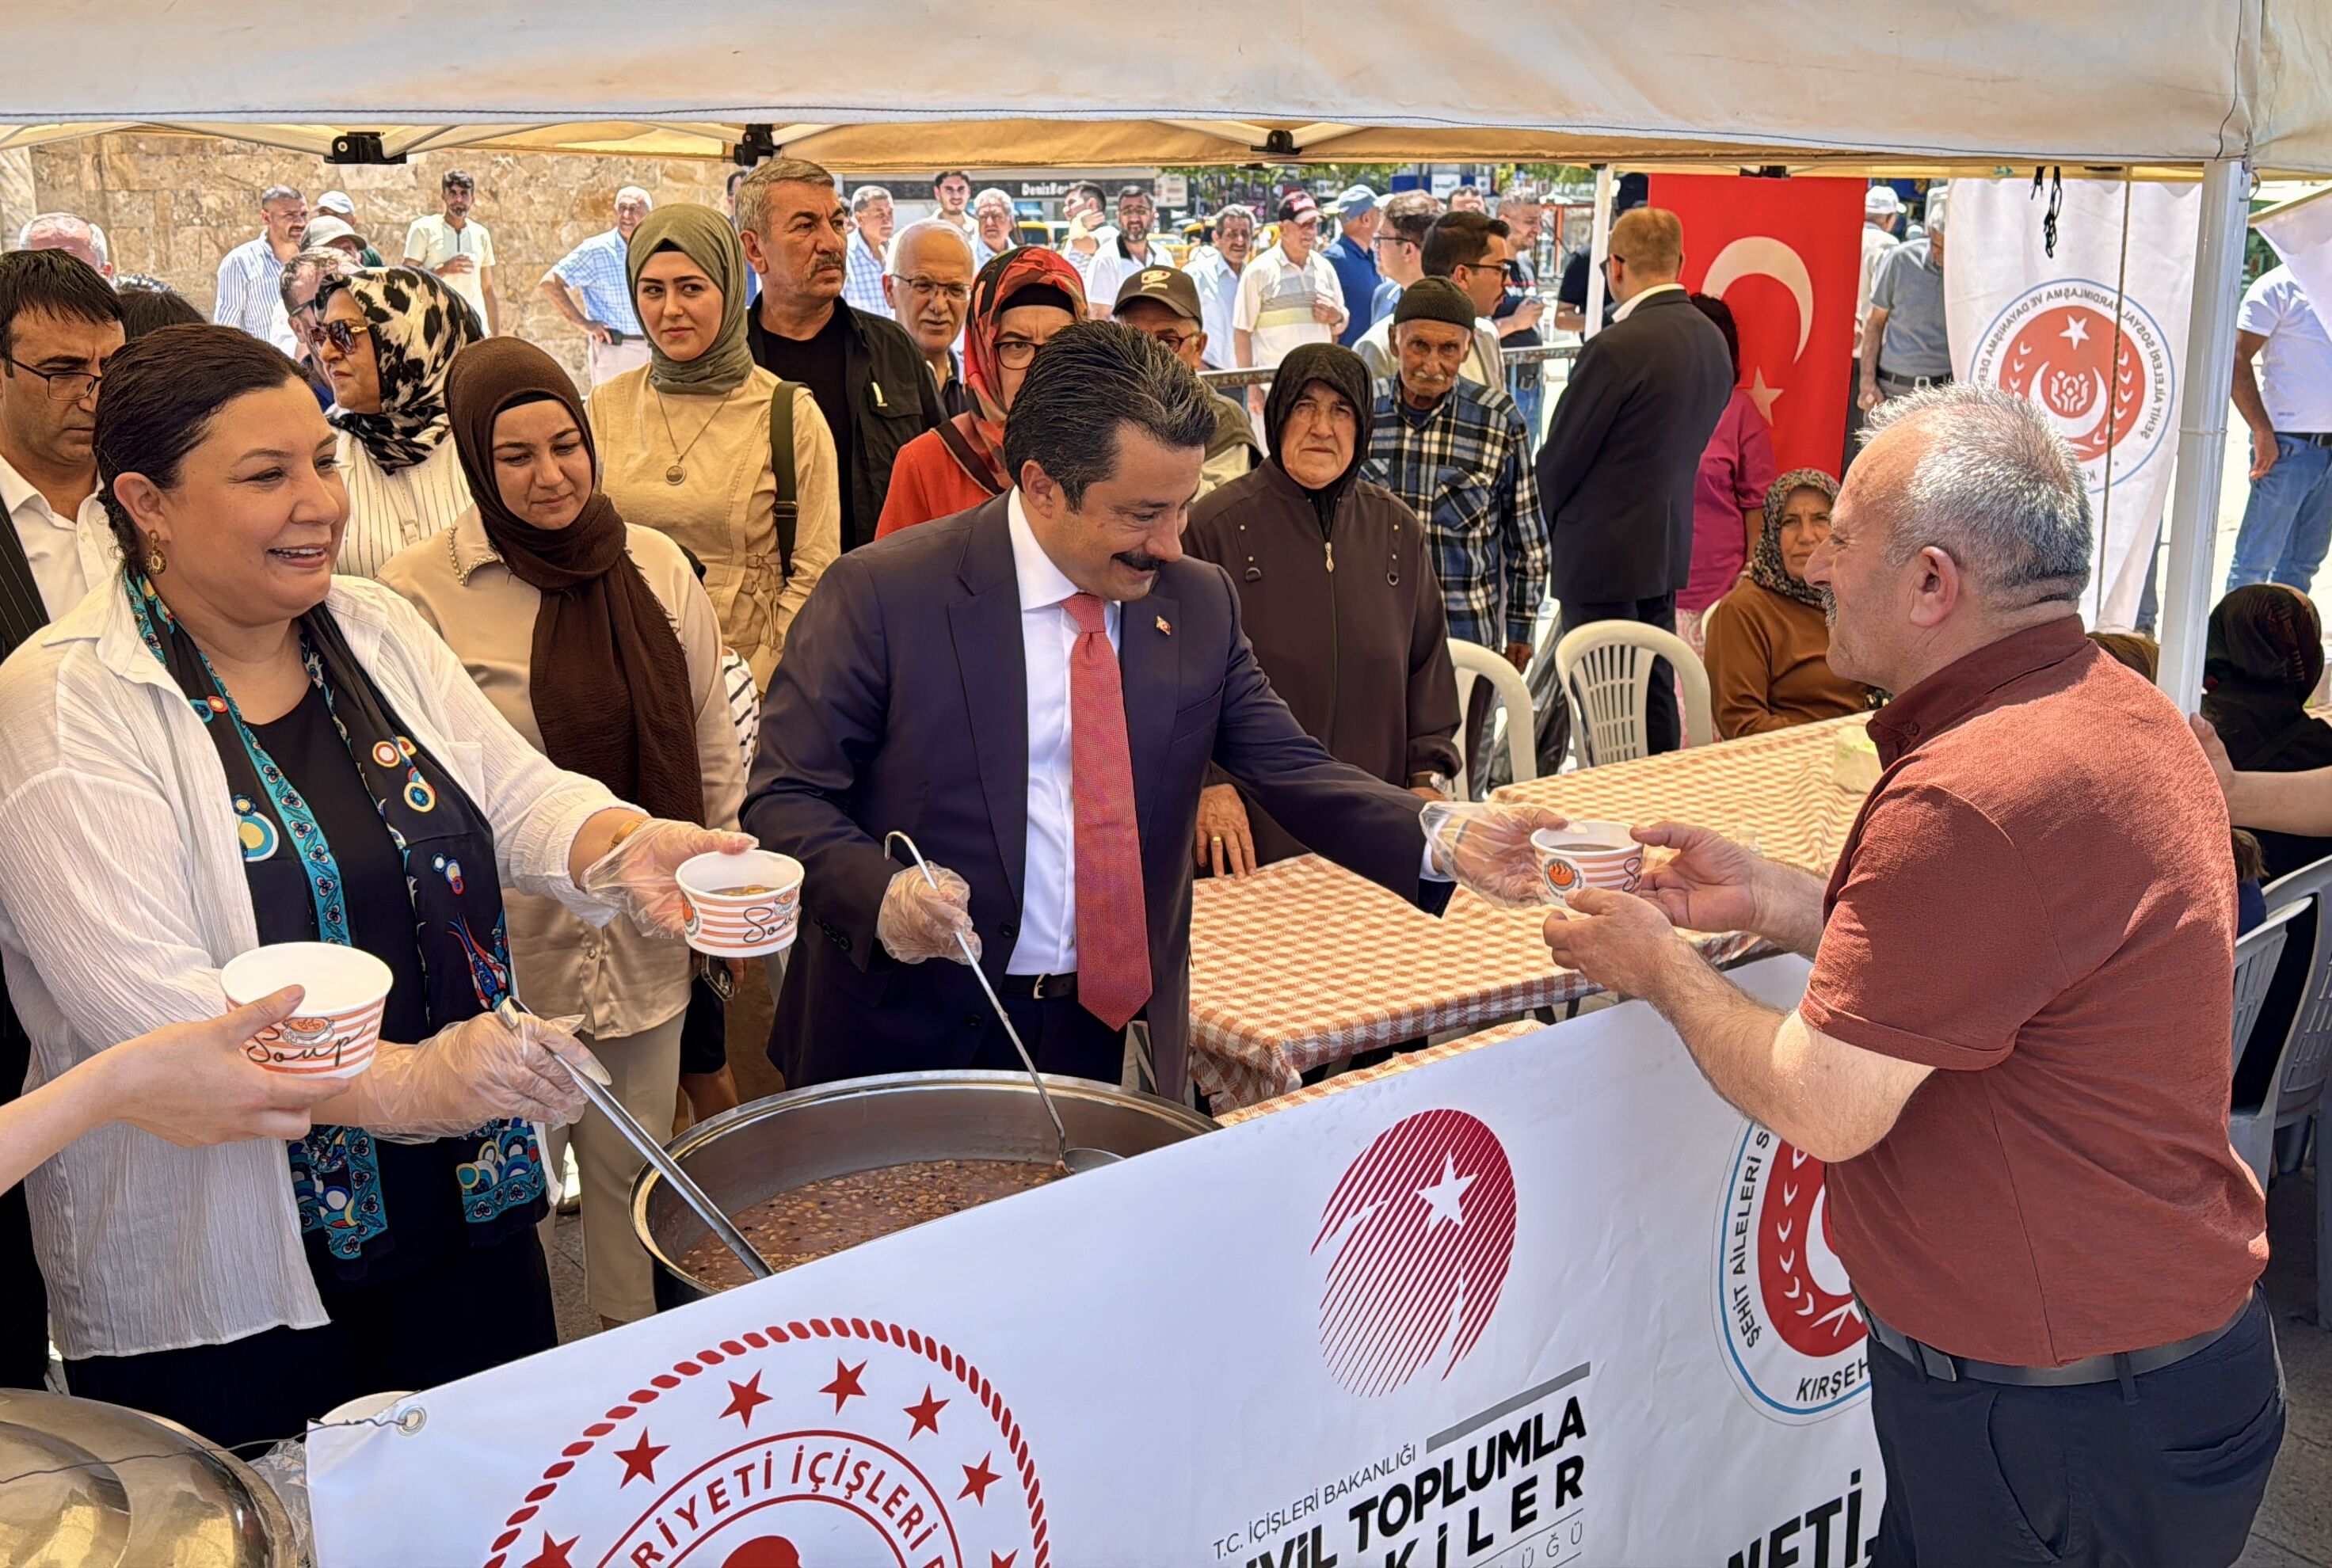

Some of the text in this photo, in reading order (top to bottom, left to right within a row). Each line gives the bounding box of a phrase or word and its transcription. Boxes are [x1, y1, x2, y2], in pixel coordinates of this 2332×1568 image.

[246, 1023, 367, 1067] Soup
[1729, 1155, 1762, 1276] AİLELERİ
[1732, 1285, 1762, 1349] ŞEHİT
[791, 1444, 939, 1551] İÇİŞLERİ
[1213, 1443, 1416, 1560] T.C. İÇİŞLERİ BAKANLIĞI
[1246, 1395, 1587, 1568] VİL TOPLUMLA
